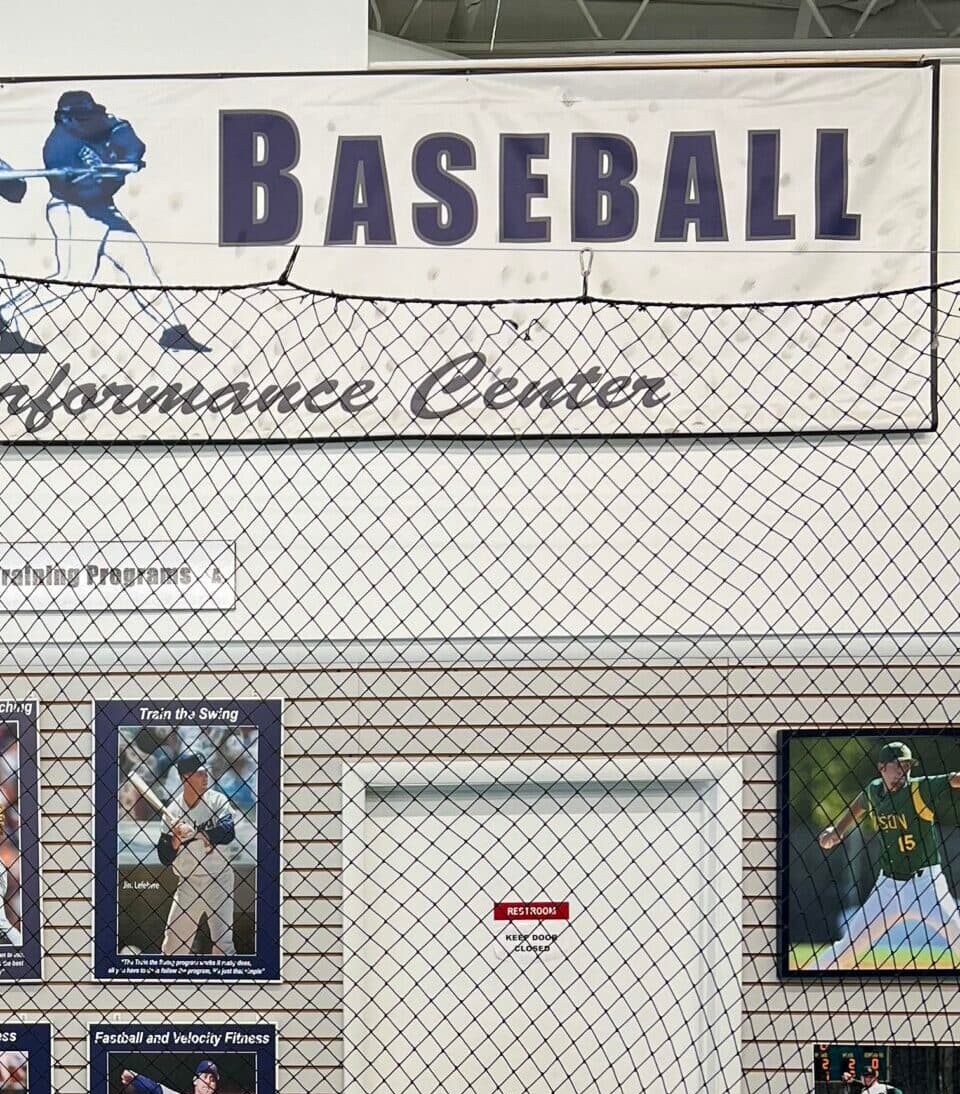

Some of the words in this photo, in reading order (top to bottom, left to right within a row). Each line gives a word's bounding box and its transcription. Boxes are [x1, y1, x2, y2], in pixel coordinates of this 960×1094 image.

[218, 109, 862, 247] BASEBALL
[409, 352, 672, 420] Center
[86, 564, 192, 588] Programs
[140, 707, 172, 720] Train
[175, 707, 196, 720] the
[199, 707, 239, 723] Swing
[898, 834, 916, 852] 15
[507, 906, 557, 916] RESTROOM
[94, 1032, 143, 1044] Fastball
[146, 1032, 169, 1044] and
[173, 1032, 222, 1047] Velocity
[224, 1032, 270, 1044] Fitness
